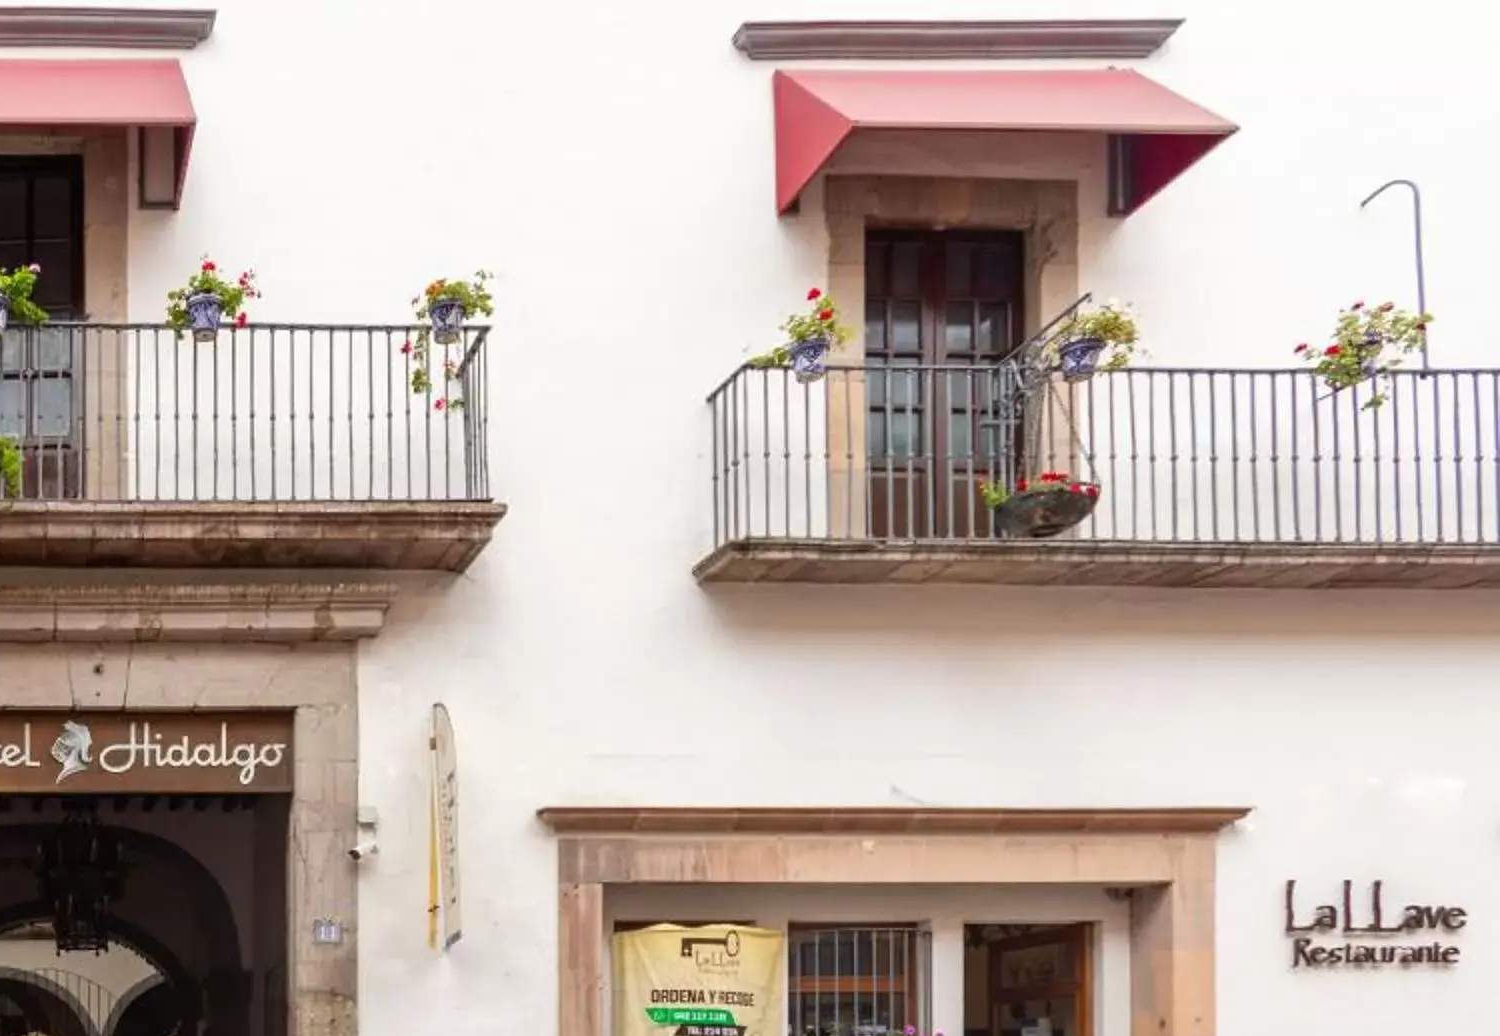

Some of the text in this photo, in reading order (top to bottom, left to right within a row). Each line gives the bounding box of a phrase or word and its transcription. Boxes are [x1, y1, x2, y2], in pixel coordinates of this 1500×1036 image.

[99, 721, 287, 785] Hidalgo
[1292, 937, 1461, 968] Restaurante
[650, 989, 706, 1004] ORDENA
[708, 989, 717, 1005] Y
